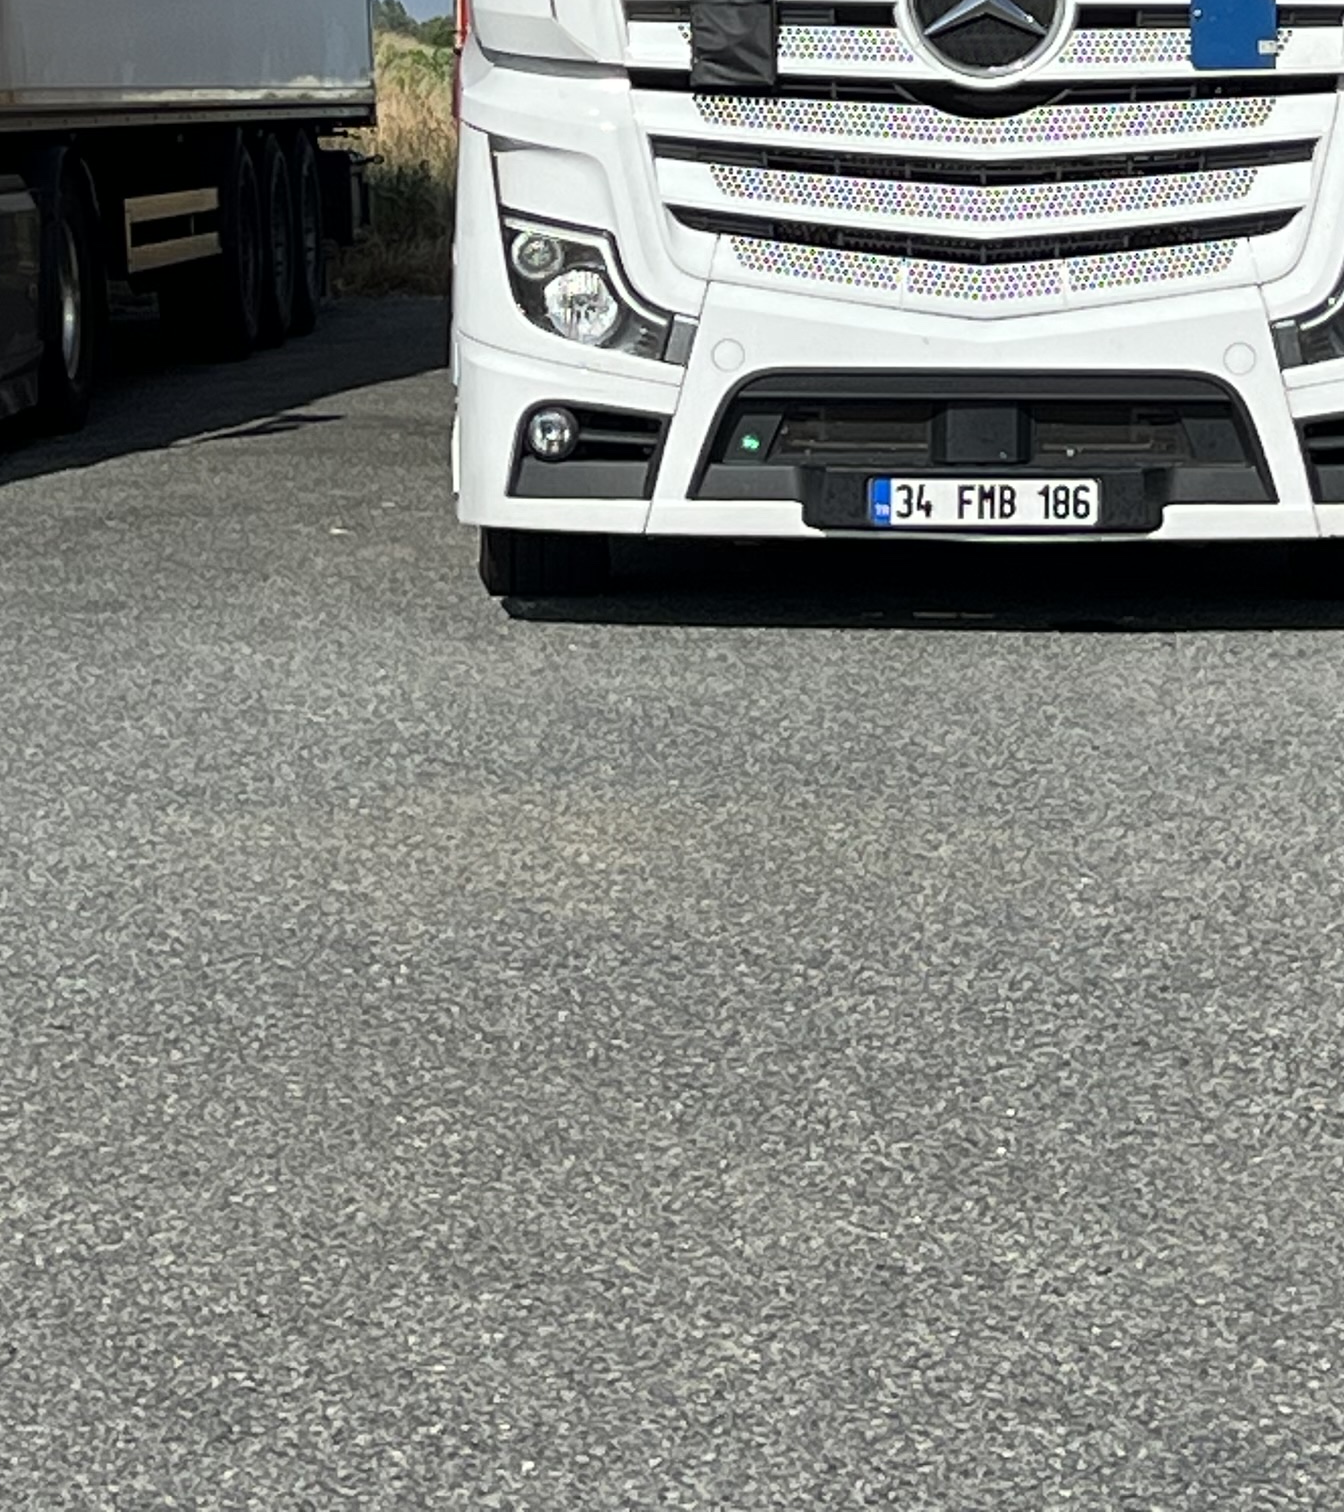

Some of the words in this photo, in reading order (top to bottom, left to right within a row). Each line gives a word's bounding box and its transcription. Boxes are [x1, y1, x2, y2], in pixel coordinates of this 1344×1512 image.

[895, 483, 933, 519] 34
[957, 484, 1017, 519] FMB
[1037, 485, 1090, 520] 186
